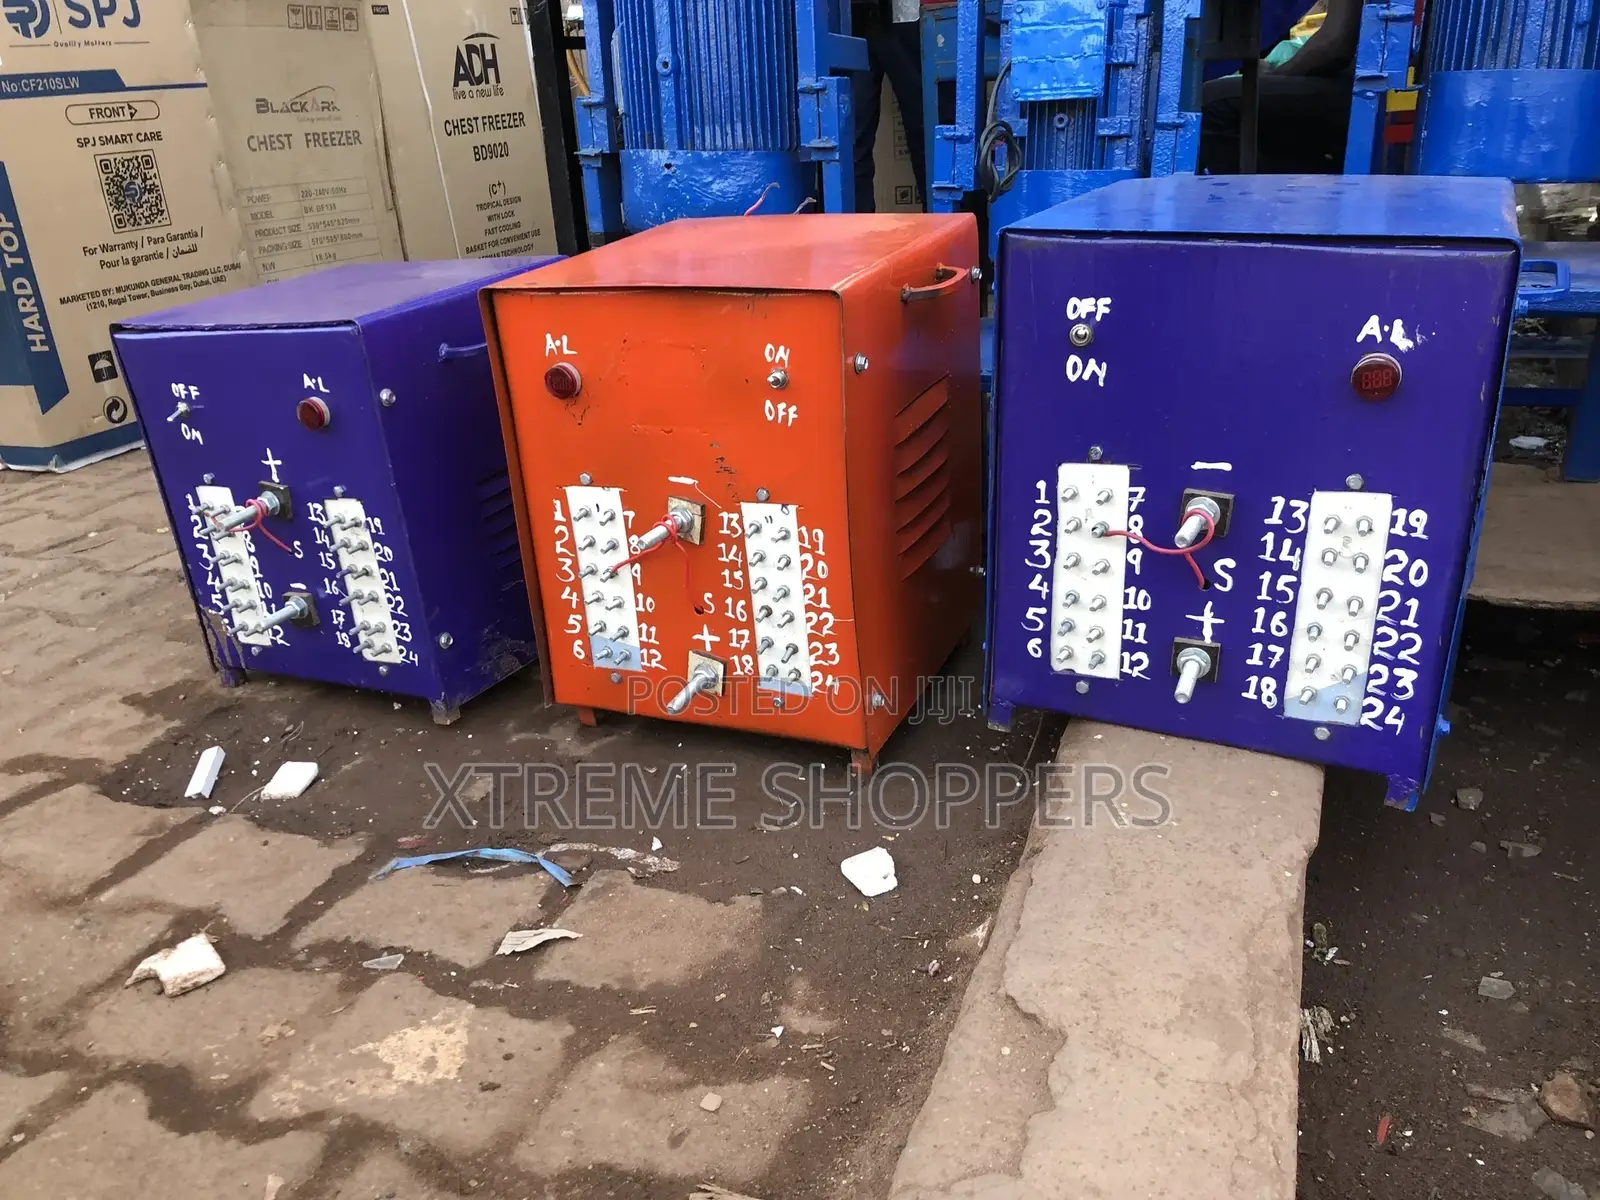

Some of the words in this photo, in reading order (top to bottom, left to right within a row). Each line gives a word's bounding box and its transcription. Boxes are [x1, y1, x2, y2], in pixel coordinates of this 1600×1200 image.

[68, 0, 142, 28] SPJ
[53, 40, 82, 49] Quality
[453, 43, 501, 88] ADH
[452, 88, 467, 100] live
[468, 90, 474, 99] a
[475, 88, 492, 98] new
[492, 84, 504, 97] life
[89, 106, 126, 119] FRONT
[444, 116, 479, 137] CHEST
[481, 111, 526, 132] FREEZER
[76, 136, 96, 148] SPJ
[98, 133, 134, 146] SMART
[136, 131, 163, 143] CARE
[247, 133, 293, 152] CHEST
[304, 130, 363, 149] FREEZER
[472, 141, 509, 162] BD9020
[246, 194, 271, 204] POWER
[475, 201, 503, 212] TROPICAL
[502, 195, 522, 206] DESIGN
[250, 210, 274, 221] MODEL
[487, 213, 501, 222] WITH
[501, 210, 516, 220] LOCK
[254, 226, 286, 238] PRODUCT
[287, 223, 302, 234] SIZE
[484, 226, 498, 236] FAST
[498, 221, 521, 233] COOLING
[82, 246, 98, 257] For
[99, 239, 138, 254] Warranty
[147, 235, 166, 246] Para
[166, 229, 199, 243] Garantia
[258, 242, 288, 255] PACKING
[288, 239, 303, 250] SIZE
[465, 243, 488, 255] BASKET
[488, 239, 500, 249] FOR
[499, 232, 530, 246] CONVENIENT
[530, 228, 541, 238] USE
[501, 243, 534, 258] TECHNOLOGY
[99, 259, 120, 270] Pour
[121, 256, 130, 266] la
[131, 250, 164, 266] garantie
[59, 290, 101, 305] MARKETED
[102, 287, 115, 298] BY:
[115, 281, 150, 294] MUKUNDA
[151, 275, 181, 287] GENERAL
[182, 269, 210, 281] TRADING
[223, 262, 241, 272] DUBAI
[108, 295, 127, 306] Regal
[150, 285, 179, 297] Business
[211, 274, 227, 285] UAE)
[12, 276, 50, 352] HARD
[1066, 296, 1112, 322] OFF
[764, 342, 790, 368] ON
[1065, 354, 1107, 387] ON
[171, 382, 200, 400] OFF
[764, 398, 798, 427] OFF
[181, 422, 204, 445] ON
[1035, 480, 1050, 505] 1
[1128, 486, 1146, 512] 7
[307, 502, 327, 525] 13
[552, 498, 566, 522] 1
[622, 510, 636, 529] 7
[1263, 495, 1309, 534] 13
[366, 516, 386, 536] 19
[718, 511, 742, 539] 13
[1030, 509, 1052, 537] 2
[1128, 514, 1144, 544] 8
[1389, 507, 1429, 540] 19
[243, 529, 256, 553] 8
[293, 540, 304, 559] S
[312, 526, 330, 549] 14
[554, 525, 575, 557] 2
[628, 534, 641, 554] 8
[797, 525, 825, 556] 19
[318, 551, 336, 570] 15
[373, 541, 394, 563] 20
[717, 542, 743, 568] 14
[1025, 539, 1051, 569] 3
[1126, 548, 1143, 575] 9
[1258, 531, 1301, 571] 14
[249, 555, 264, 579] 9
[555, 557, 575, 583] 3
[631, 562, 642, 586] 9
[800, 552, 829, 581] 20
[1213, 558, 1236, 592] S
[1382, 548, 1429, 588] 20
[255, 579, 273, 599] 10
[323, 577, 339, 595] 16
[379, 567, 401, 592] 21
[721, 568, 744, 590] 15
[1028, 573, 1049, 600] 4
[1256, 570, 1297, 604] 15
[385, 592, 408, 617] 22
[561, 586, 580, 609] 4
[634, 592, 655, 613] 10
[703, 592, 716, 614] S
[803, 582, 831, 609] 21
[1122, 586, 1151, 610] 10
[331, 608, 346, 629] 17
[724, 596, 747, 622] 16
[1021, 607, 1047, 631] 5
[1376, 589, 1419, 628] 21
[391, 619, 412, 643] 23
[563, 614, 583, 634] 5
[638, 622, 660, 645] 11
[804, 611, 837, 638] 22
[1122, 619, 1147, 644] 11
[1251, 606, 1288, 637] 16
[335, 631, 351, 649] 18
[572, 639, 586, 660] 6
[728, 627, 750, 650] 17
[1027, 638, 1042, 658] 6
[1373, 625, 1423, 665] 22
[397, 645, 419, 667] 24
[640, 648, 668, 671] 12
[729, 654, 755, 676] 18
[808, 641, 840, 667] 23
[1120, 651, 1151, 680] 12
[1245, 642, 1284, 669] 17
[1241, 675, 1278, 709] 18
[1366, 663, 1418, 700] 23
[1360, 696, 1405, 736] 24
